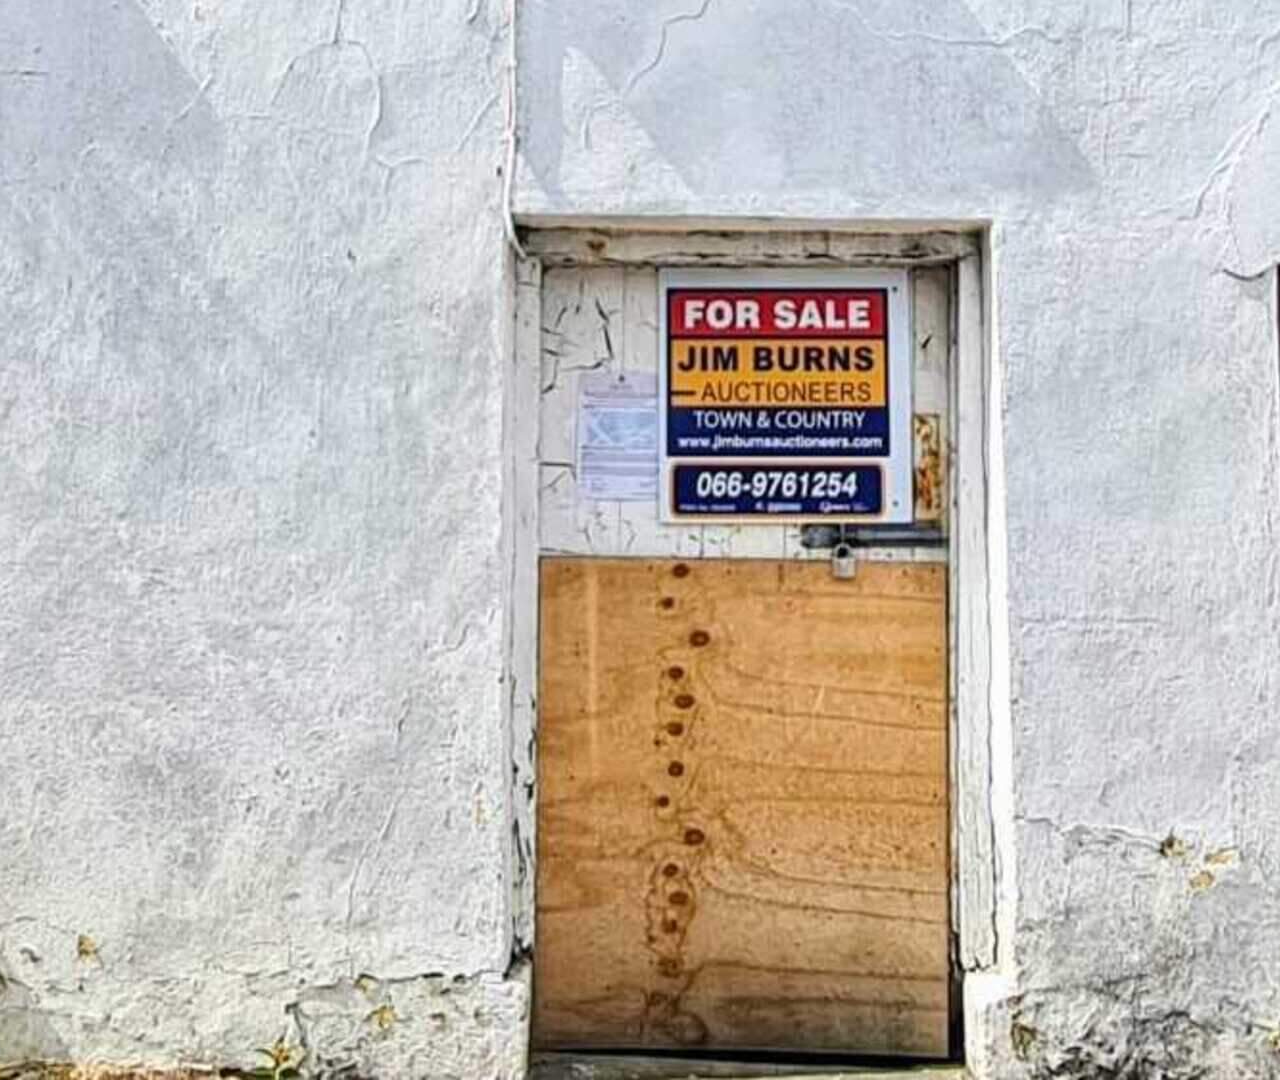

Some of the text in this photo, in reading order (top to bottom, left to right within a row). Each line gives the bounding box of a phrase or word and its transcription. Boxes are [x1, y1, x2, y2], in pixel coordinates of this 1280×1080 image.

[684, 299, 870, 329] FOR SALE
[678, 345, 874, 372] JIM BURNS
[700, 381, 871, 402] AUCTIONEERS
[694, 410, 866, 430] TOWN & COUNTRY
[677, 435, 883, 450] www.jimburnsauctioneers.com
[696, 472, 858, 498] 066-9761254
